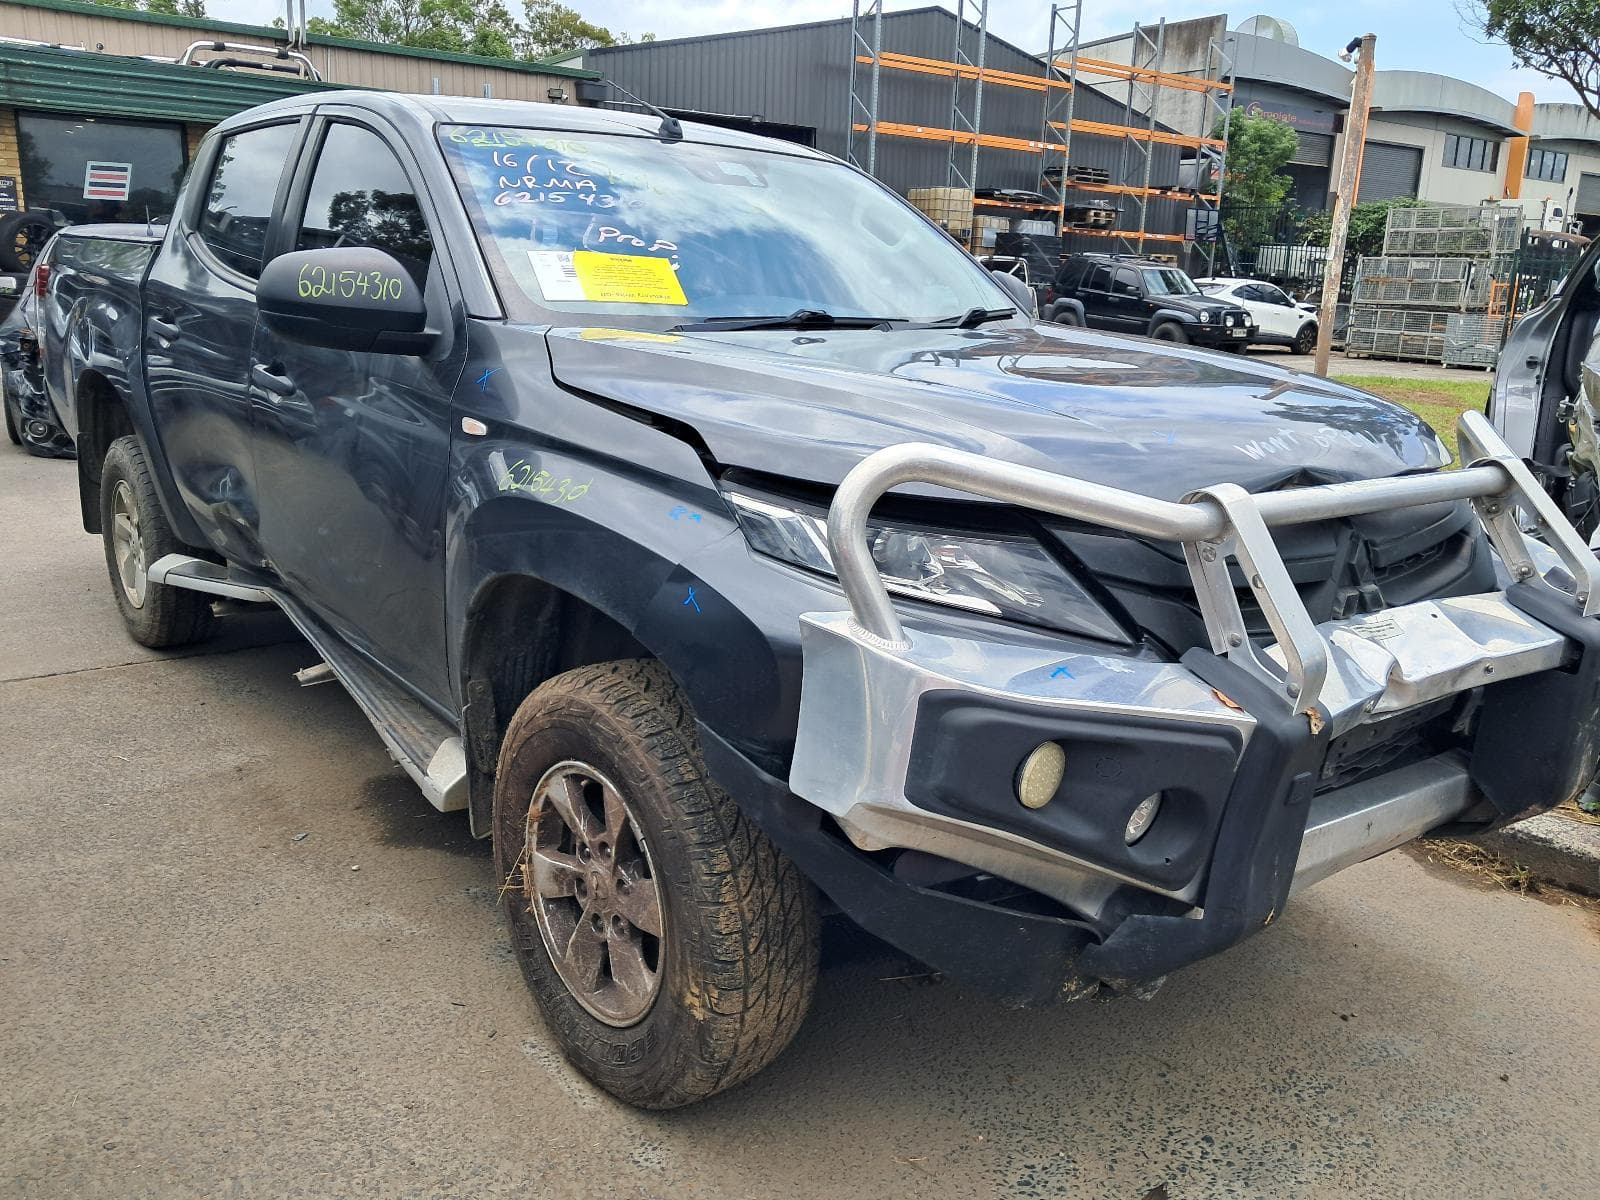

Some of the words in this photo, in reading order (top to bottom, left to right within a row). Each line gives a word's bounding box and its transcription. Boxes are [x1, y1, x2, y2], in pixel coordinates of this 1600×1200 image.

[499, 175, 598, 192] NRMA
[493, 190, 645, 209] 6215430
[297, 263, 402, 301] 62154310
